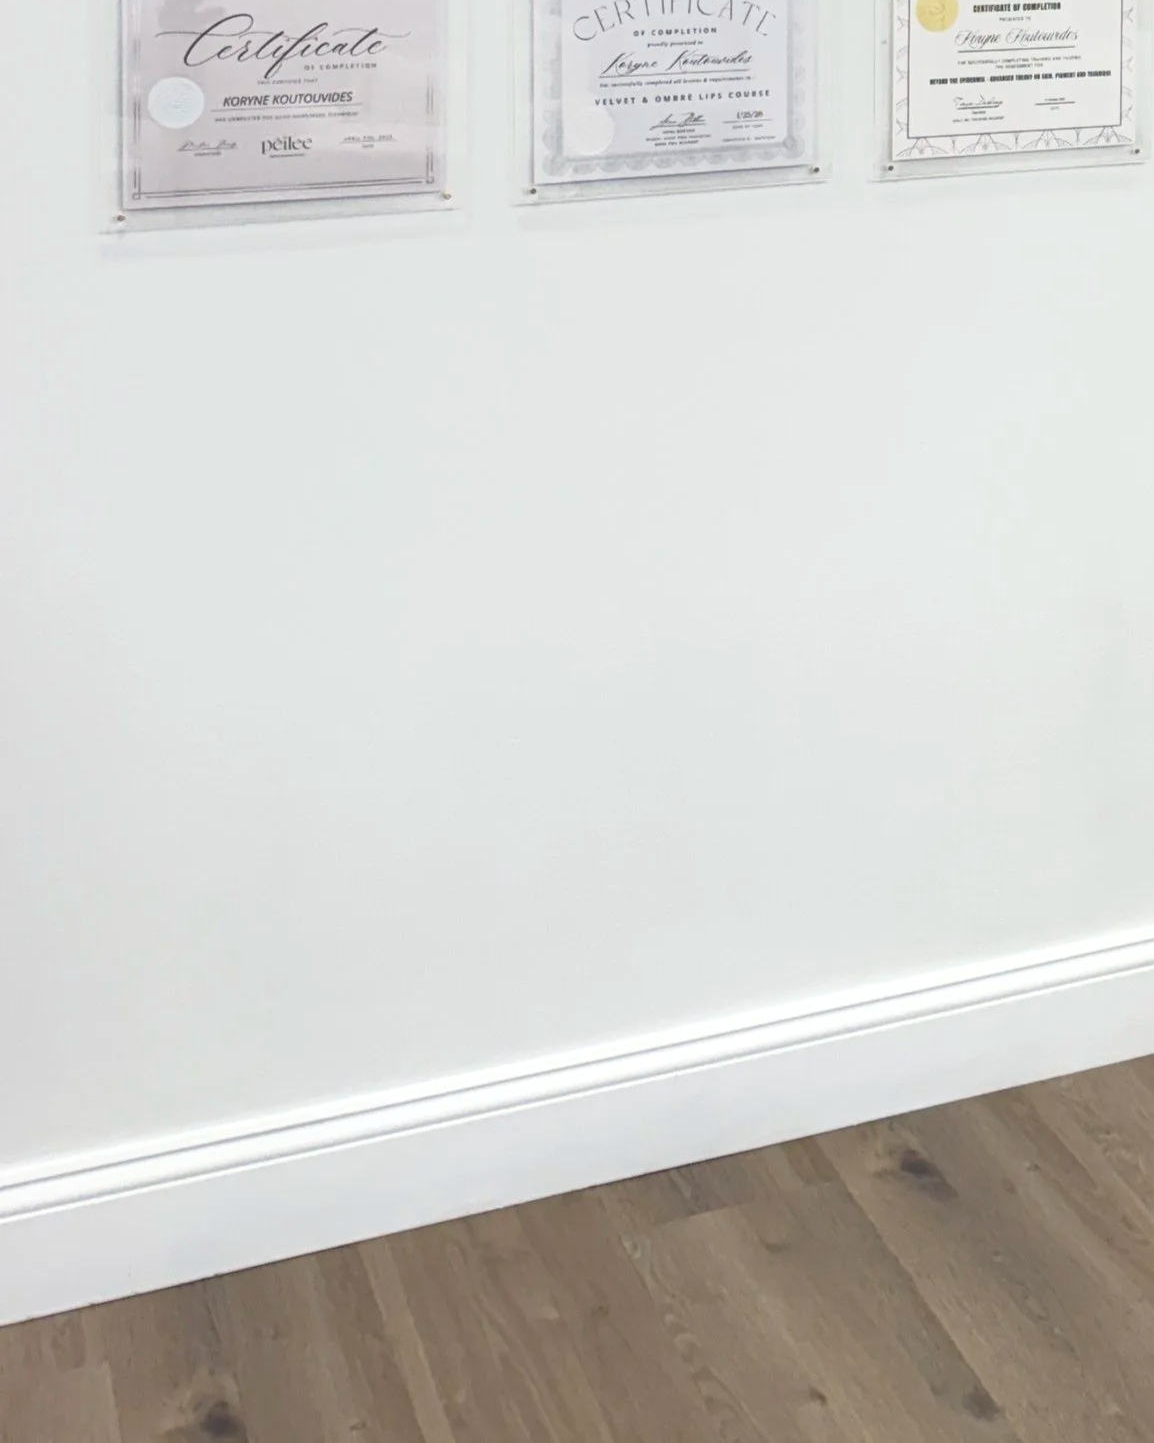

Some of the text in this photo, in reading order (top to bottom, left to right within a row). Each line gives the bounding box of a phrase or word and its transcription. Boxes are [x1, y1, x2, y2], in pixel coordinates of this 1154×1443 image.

[973, 2, 1061, 13] CERTIFICATE OF COMPLETION
[651, 27, 718, 37] COMPLETION
[154, 13, 411, 80] Certificate
[223, 91, 355, 108] KORYNE KOUTOUVIDES
[595, 97, 636, 106] VELVET
[642, 95, 649, 104] &
[699, 92, 724, 101] LIPS
[728, 90, 771, 99] COURSE
